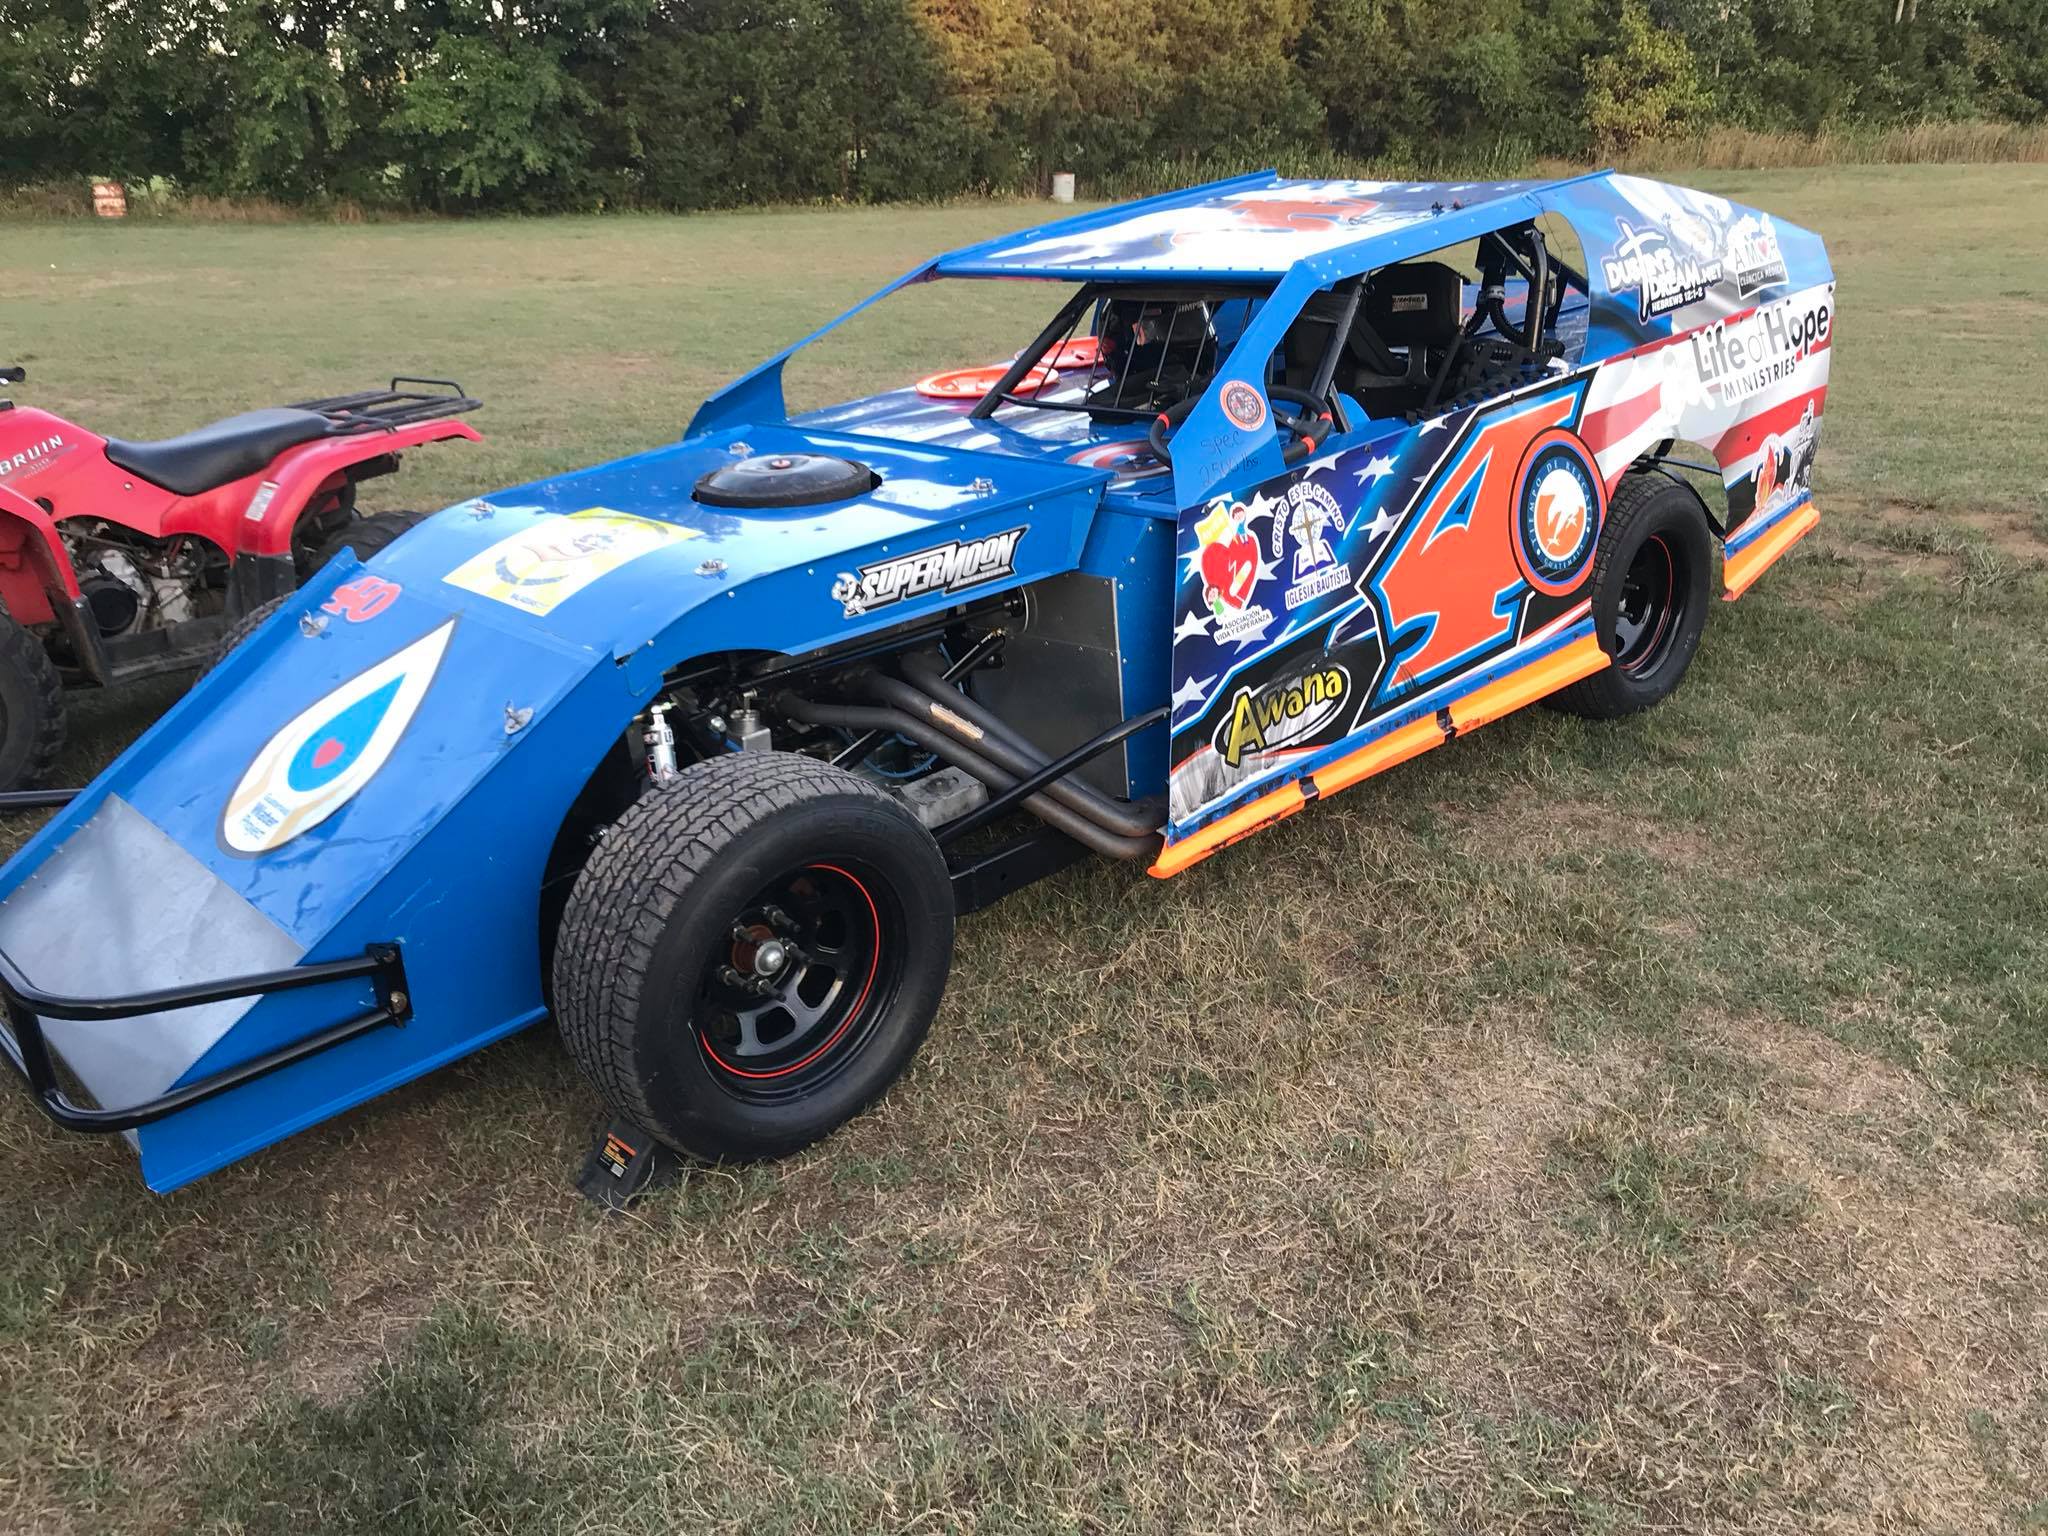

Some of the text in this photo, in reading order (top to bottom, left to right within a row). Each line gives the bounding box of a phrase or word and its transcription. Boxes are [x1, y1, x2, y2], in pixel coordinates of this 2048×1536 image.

[1652, 296, 1683, 312] HEBREWS
[1692, 305, 1829, 383] Life of Hope
[1723, 356, 1796, 400] MINISTRIES
[0, 434, 63, 475] BRUIN
[1273, 484, 1344, 555] CRISTO ES EL CAMINO
[1528, 461, 1593, 545] TIEMPO DE RESCATE
[861, 531, 1021, 605] SUPERMOON
[1287, 571, 1350, 607] IGLESIA BAUTISTA
[1216, 630, 1231, 642] VIDA
[1235, 613, 1271, 634] ESPERANZA
[1224, 608, 1261, 630] ASOCIACIÓN
[1225, 668, 1343, 769] Awana
